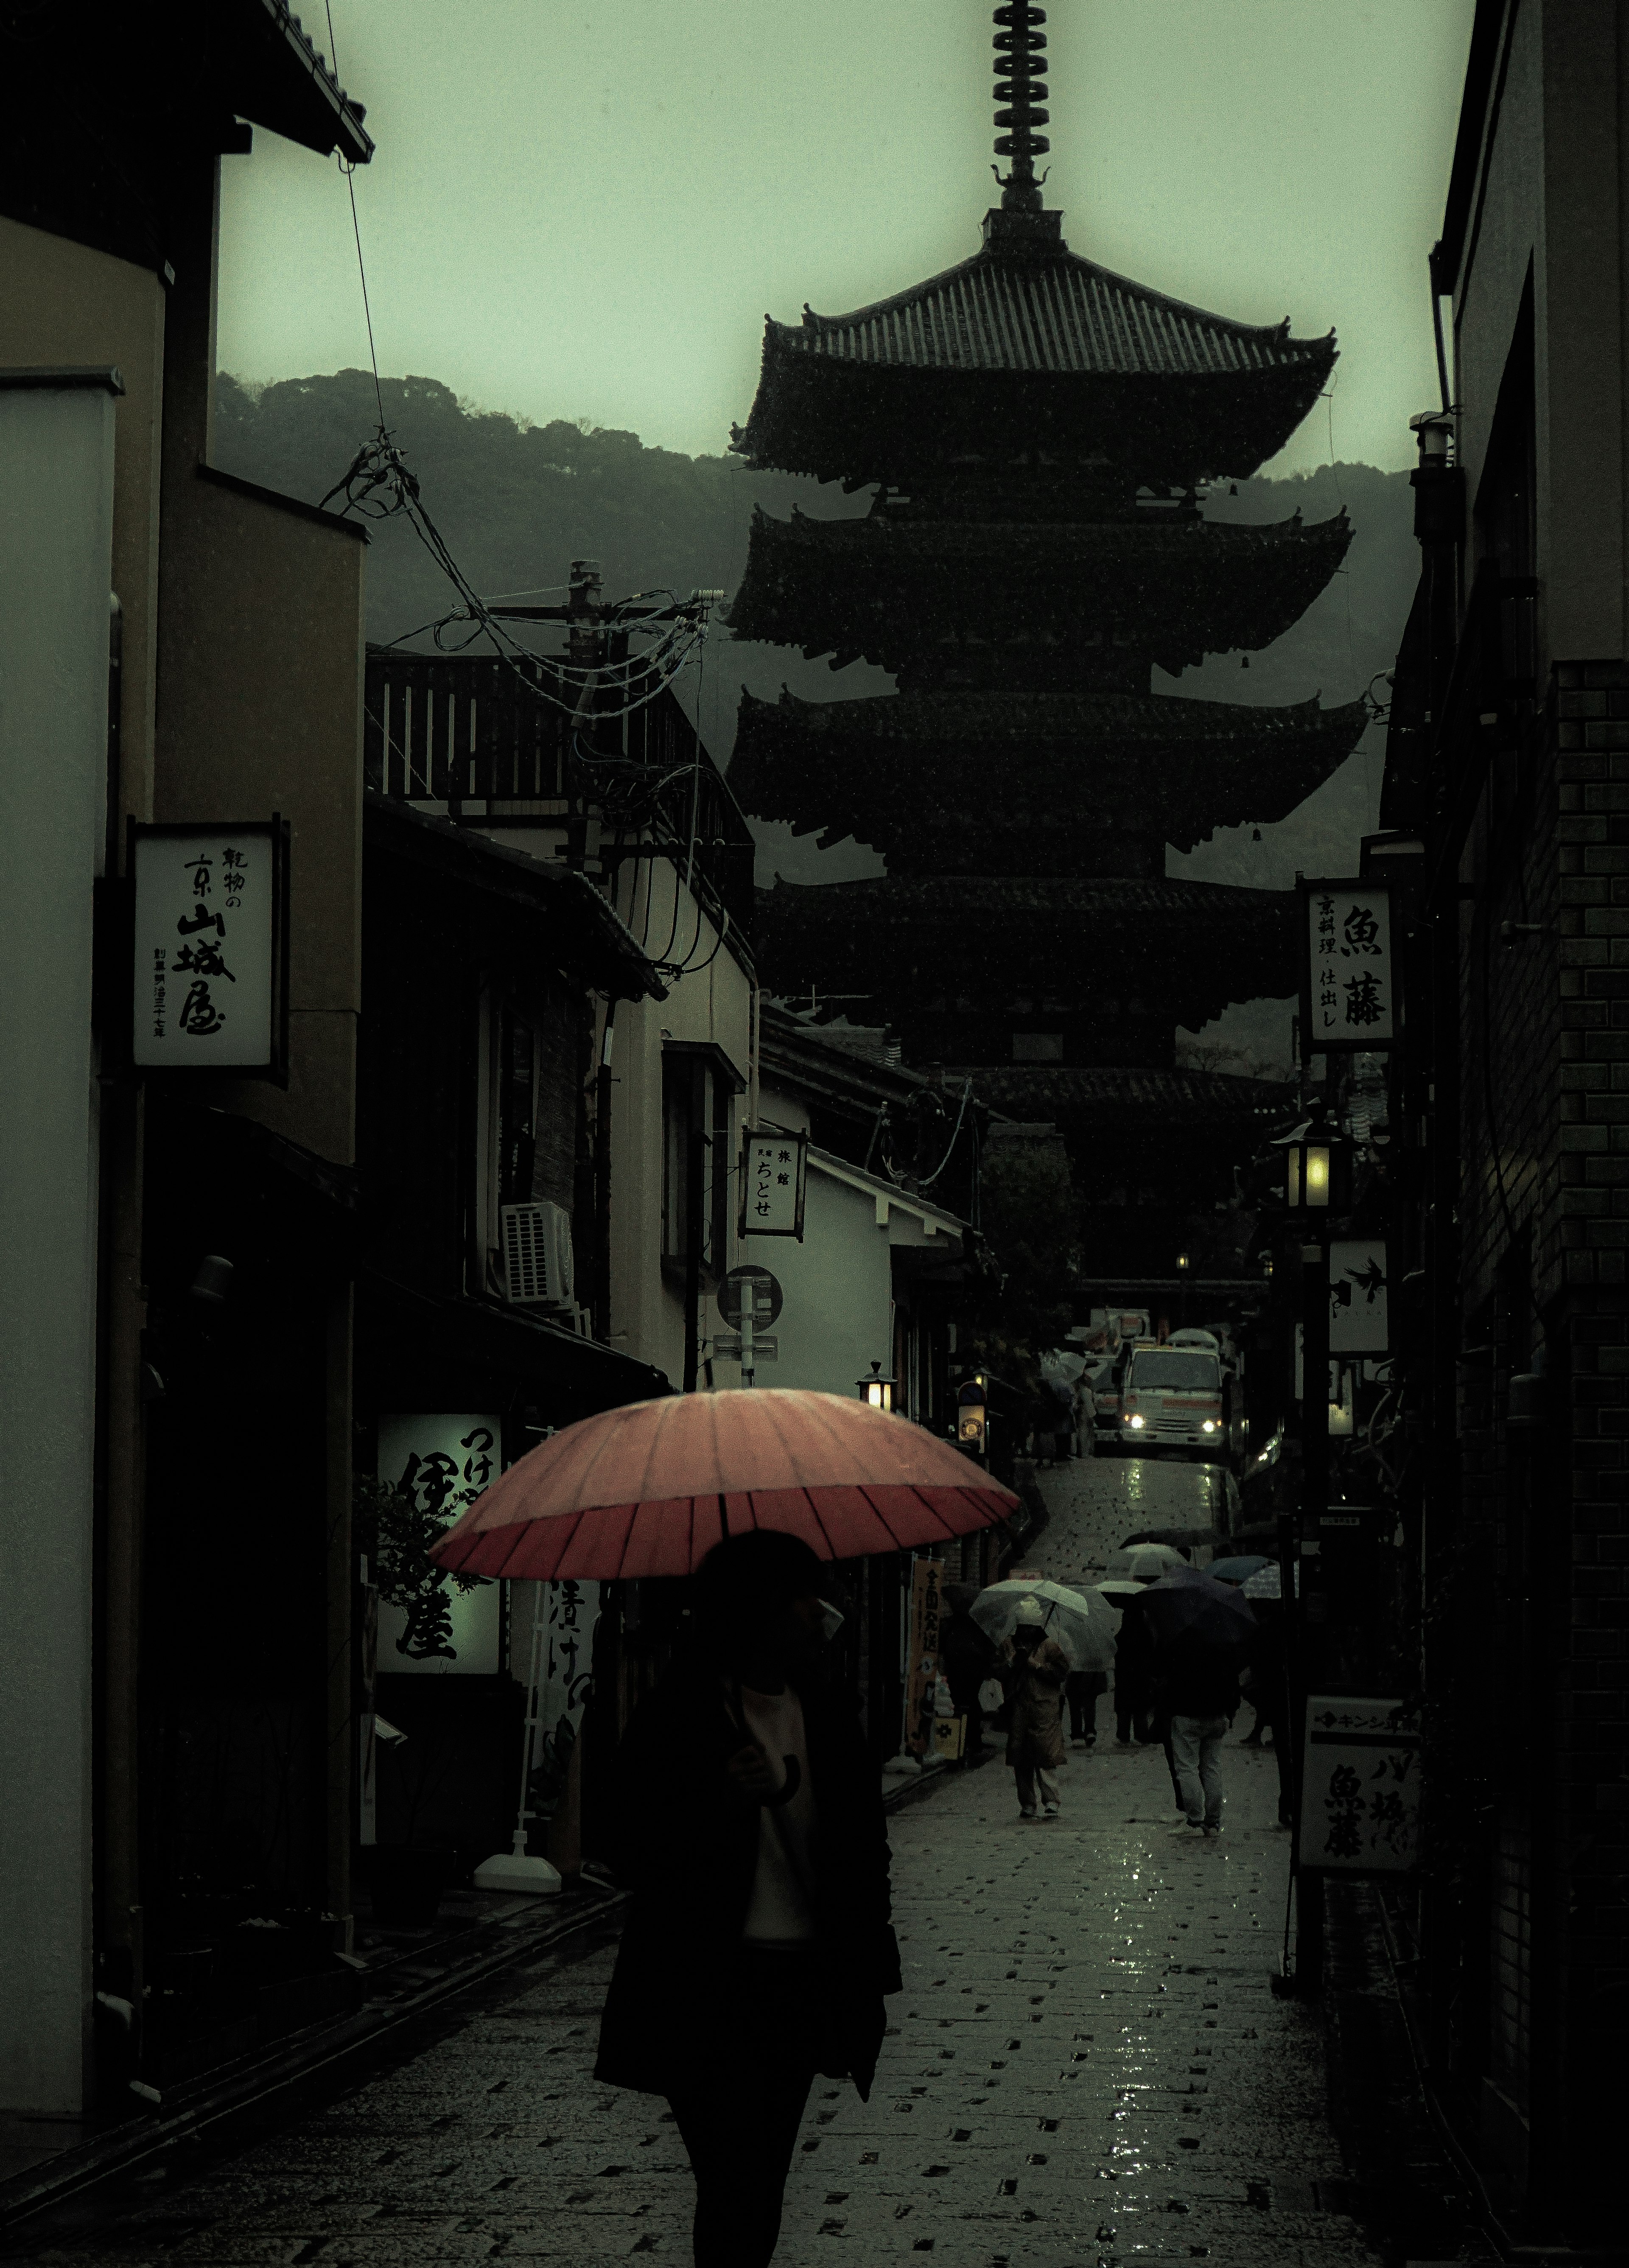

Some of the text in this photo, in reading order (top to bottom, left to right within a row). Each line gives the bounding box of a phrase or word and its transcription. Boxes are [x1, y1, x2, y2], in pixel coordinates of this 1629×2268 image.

[222, 848, 248, 908] 乾物の
[1341, 905, 1387, 1026] 魚藤
[753, 1161, 772, 1217] ちとせ
[777, 1150, 792, 1185] 旅館
[396, 1452, 459, 1660] 伊屋
